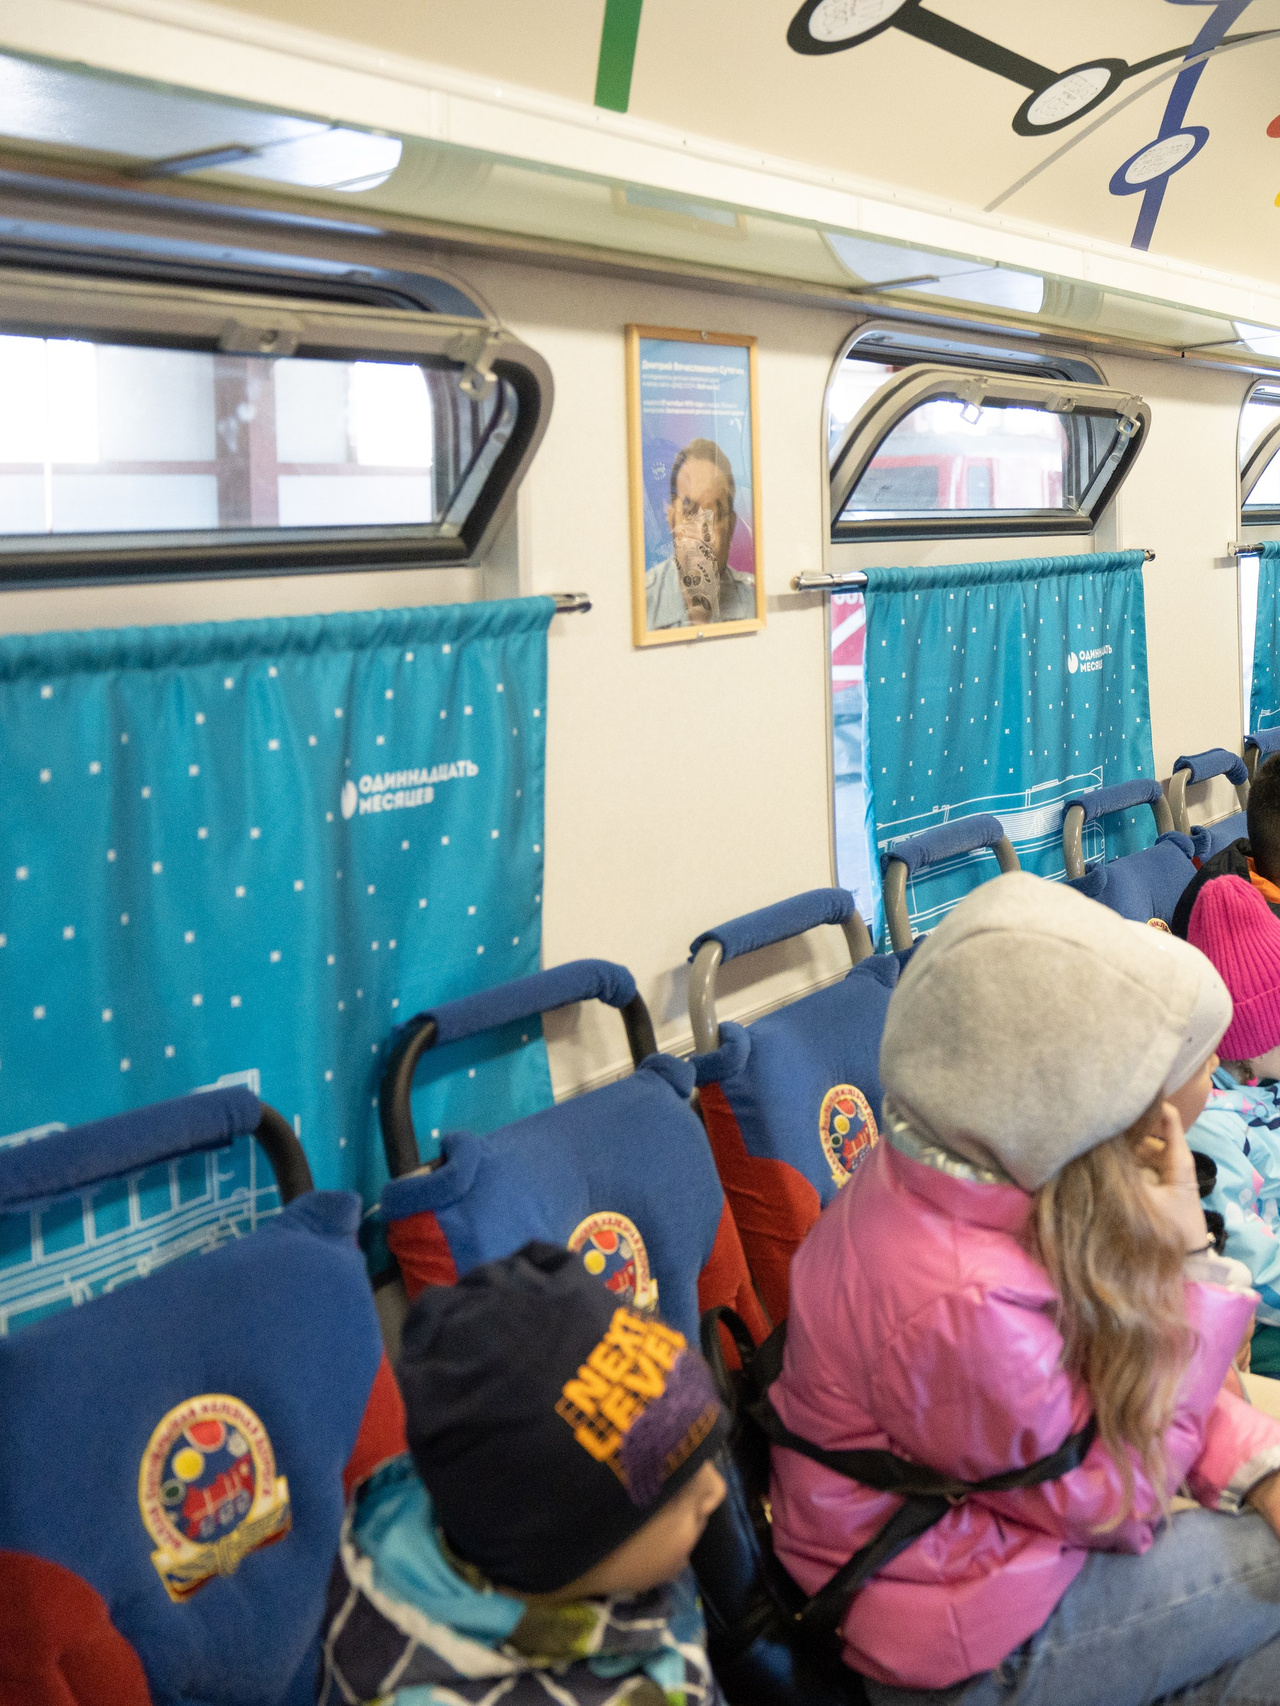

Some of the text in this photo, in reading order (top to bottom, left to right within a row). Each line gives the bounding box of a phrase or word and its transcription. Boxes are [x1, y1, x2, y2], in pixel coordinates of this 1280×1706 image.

[358, 759, 479, 795] ОДИННАДЦАТЬ
[358, 785, 435, 815] МЕСЯЦЕВ
[563, 1306, 650, 1415] NEXT
